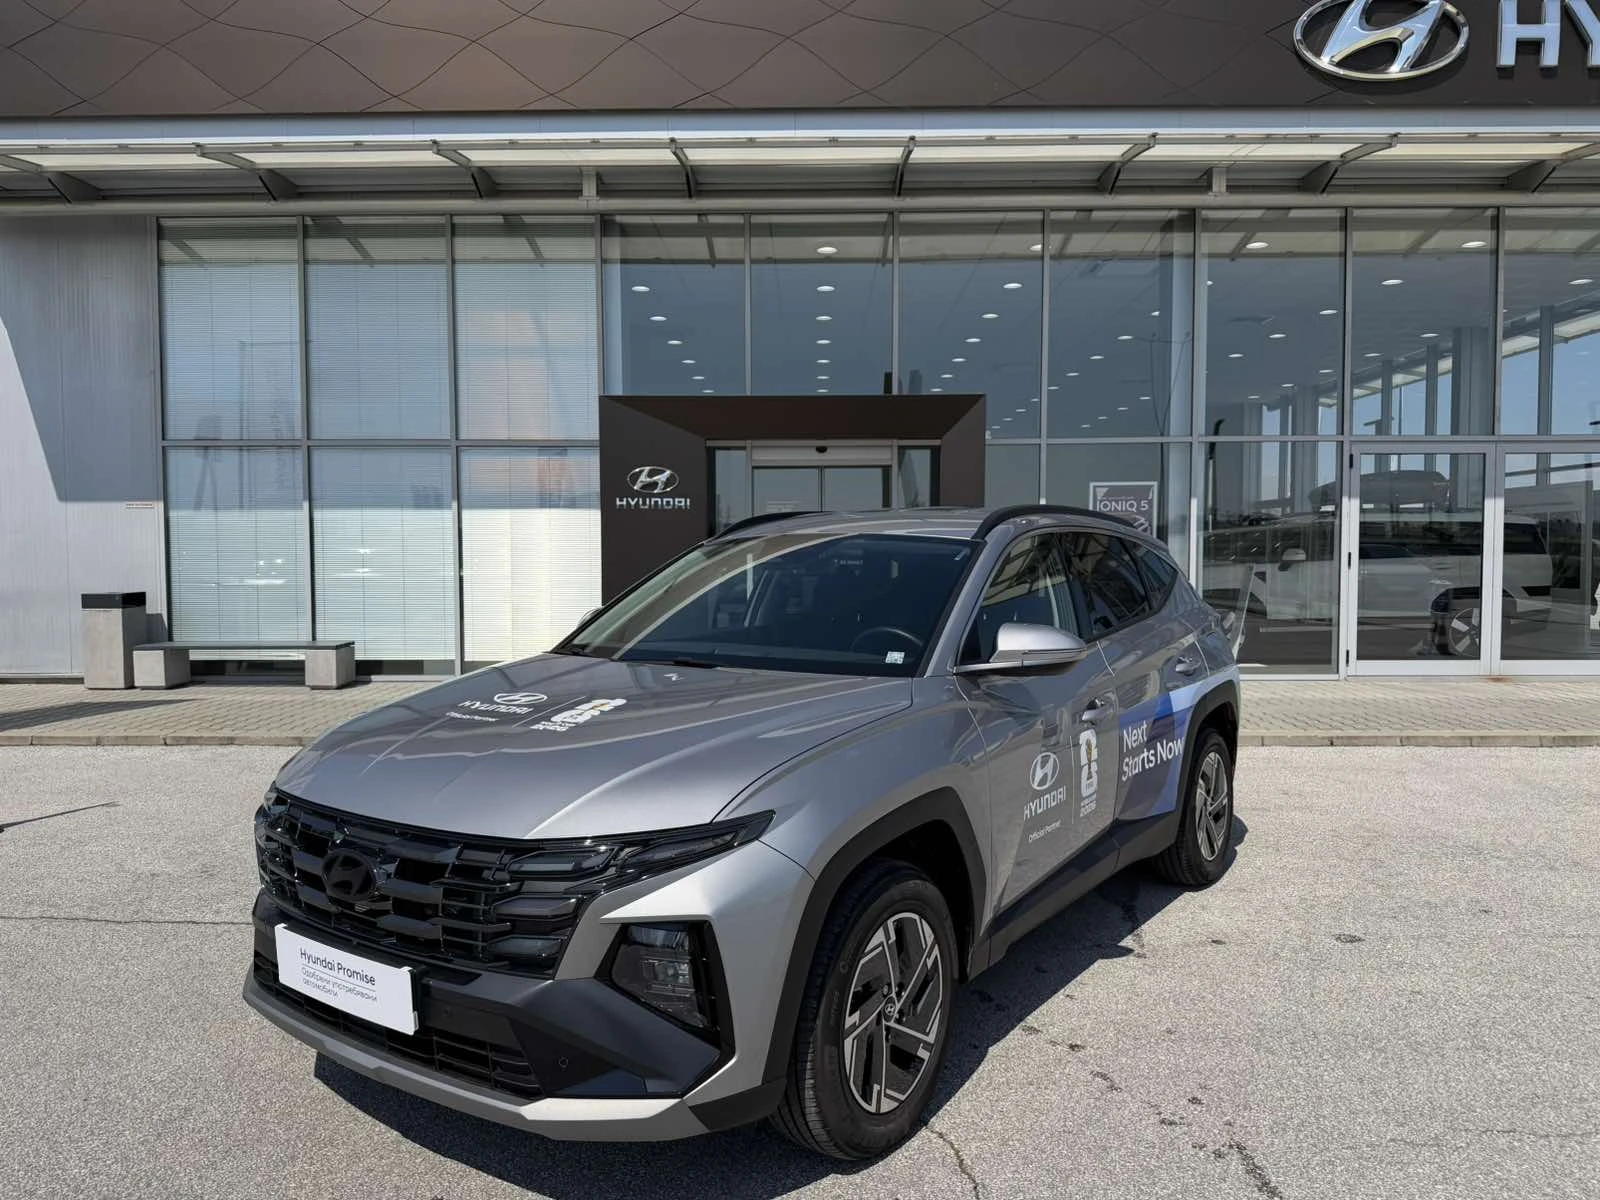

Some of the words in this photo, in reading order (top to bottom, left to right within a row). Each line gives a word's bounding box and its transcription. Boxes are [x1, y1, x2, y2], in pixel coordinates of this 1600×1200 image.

[615, 497, 690, 510] HYUNDAI
[1096, 500, 1137, 512] IONIQ
[1140, 500, 1149, 511] 5
[458, 700, 535, 715] HYUNDAI
[1123, 720, 1148, 753] Next
[1121, 749, 1155, 782] Starts
[1157, 736, 1186, 765] Now
[1023, 785, 1067, 821] HYUNDAI
[300, 948, 336, 972] Hyundai
[337, 962, 376, 986] Promise
